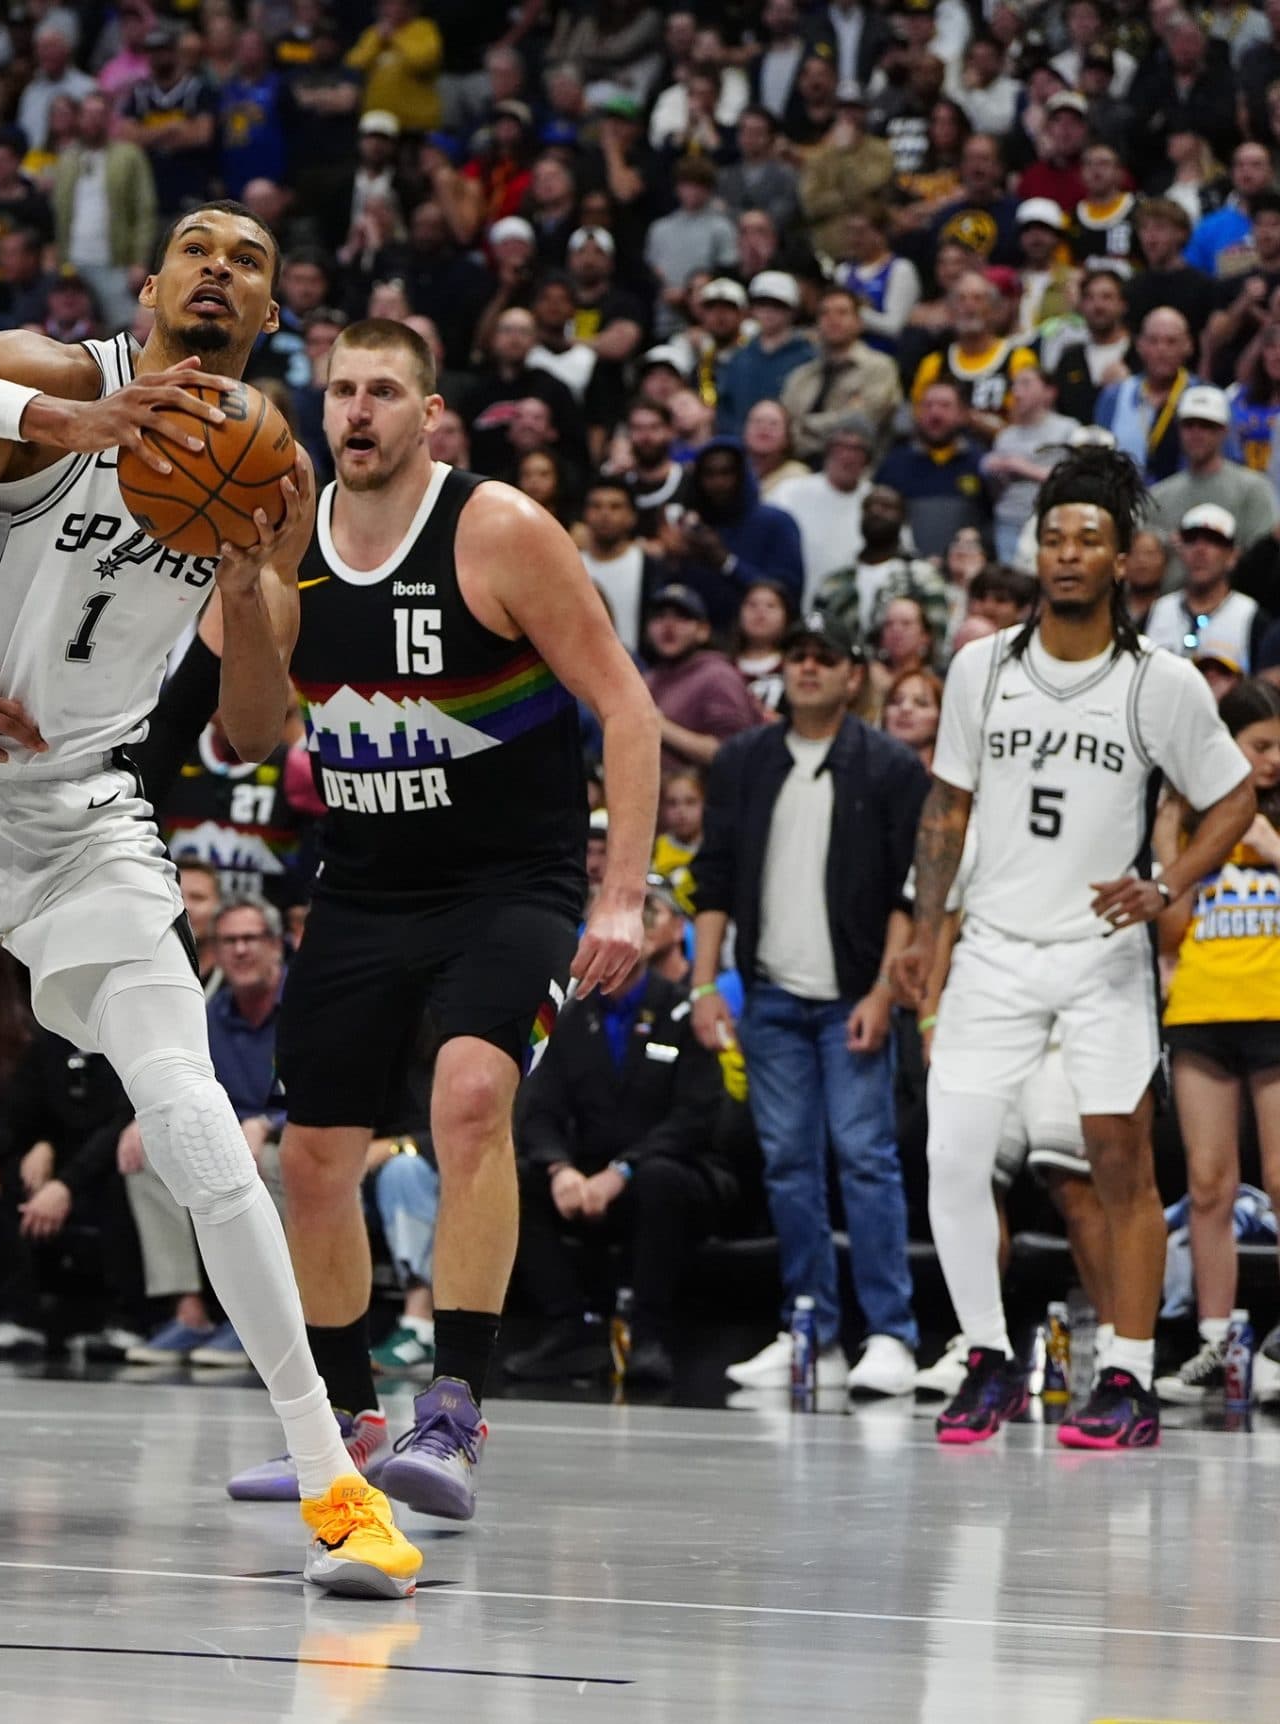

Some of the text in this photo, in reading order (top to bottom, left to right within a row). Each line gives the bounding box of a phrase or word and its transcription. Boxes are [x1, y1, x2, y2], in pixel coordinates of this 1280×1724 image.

[55, 513, 221, 588] SPURS
[393, 581, 436, 596] ibotta
[65, 591, 116, 663] 1
[393, 608, 443, 675] 15
[989, 729, 1125, 773] SPURS
[230, 784, 276, 825] 27
[321, 767, 453, 814] DENVER
[1029, 787, 1064, 839] 5
